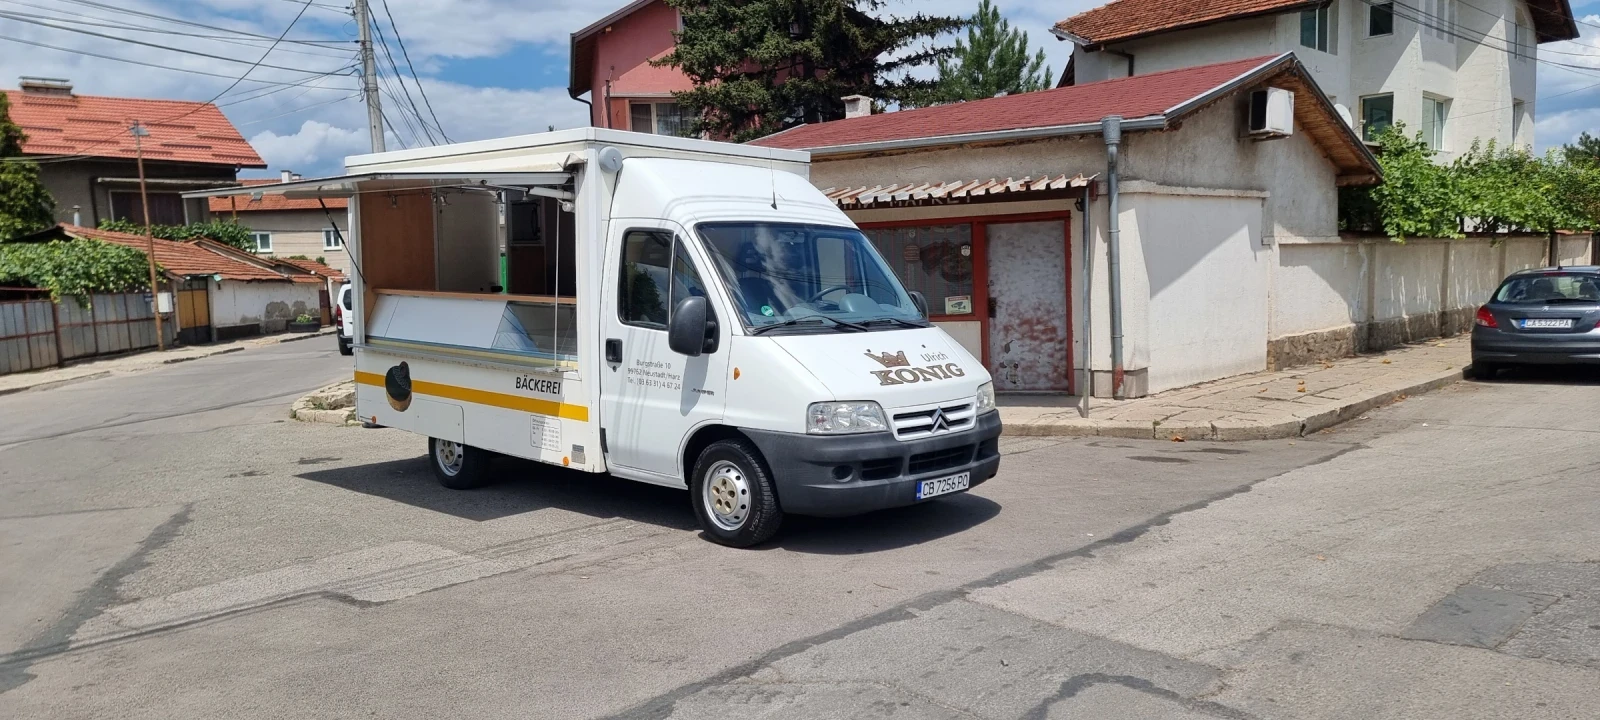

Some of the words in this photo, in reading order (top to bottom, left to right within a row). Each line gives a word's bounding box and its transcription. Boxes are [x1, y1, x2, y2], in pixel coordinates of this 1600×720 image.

[920, 351, 949, 362] Ulrich
[515, 374, 561, 395] BÄCKEREI
[936, 476, 957, 494] 7256
